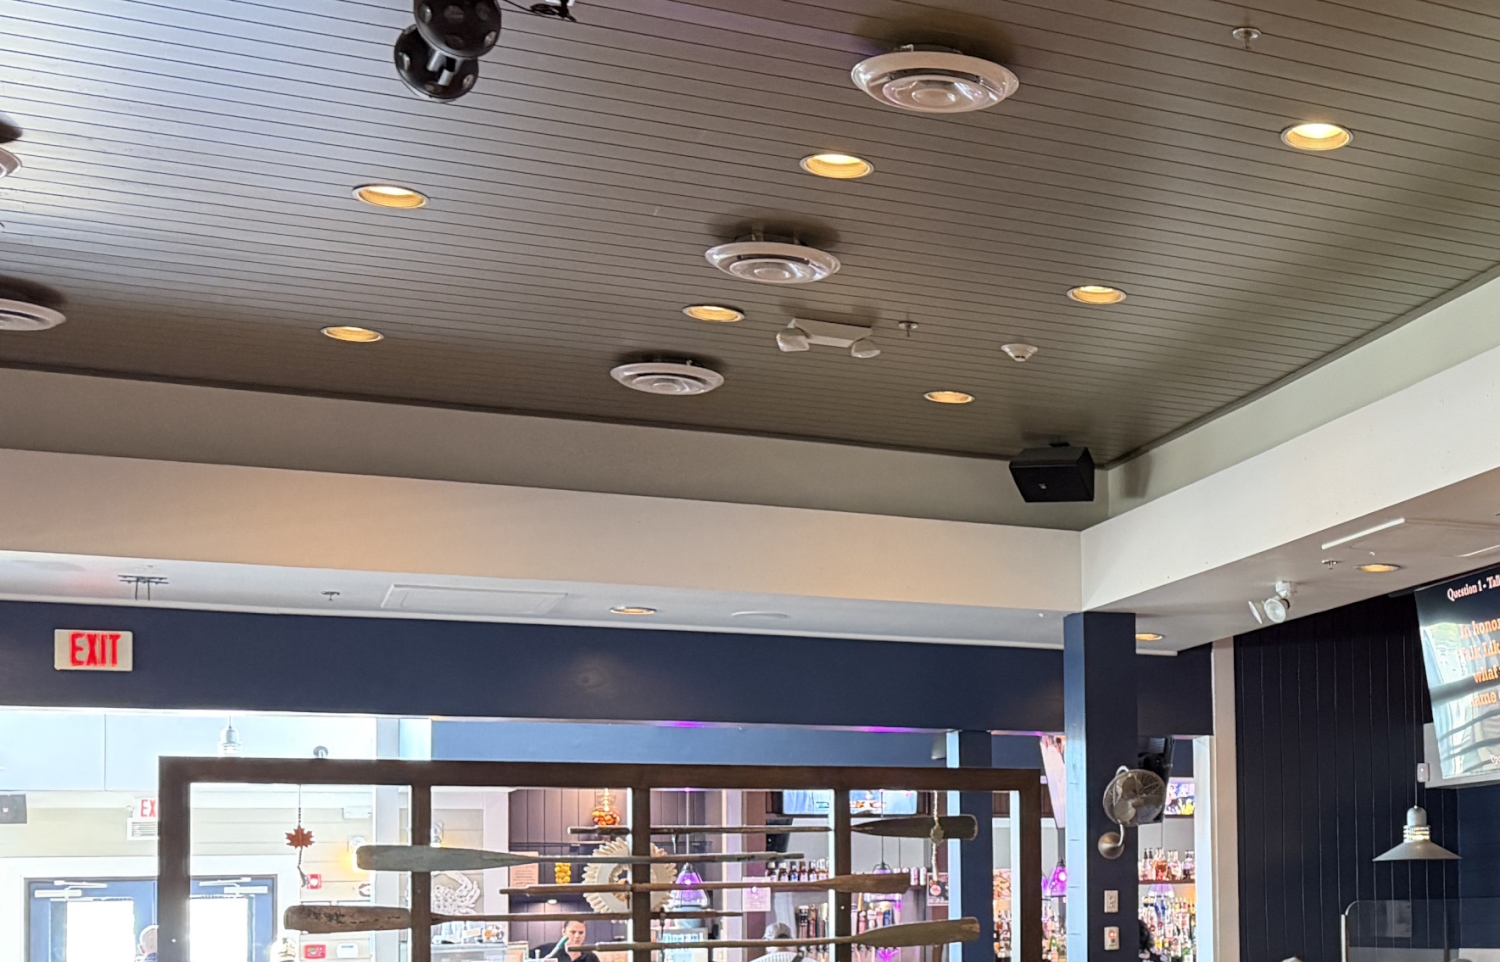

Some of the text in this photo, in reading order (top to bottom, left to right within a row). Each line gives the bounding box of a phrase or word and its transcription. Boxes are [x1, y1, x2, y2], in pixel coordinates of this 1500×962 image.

[1447, 583, 1478, 602] Question
[1459, 623, 1472, 640] In
[70, 631, 122, 667] EXIT
[1473, 666, 1498, 683] what
[141, 799, 156, 817] EX
